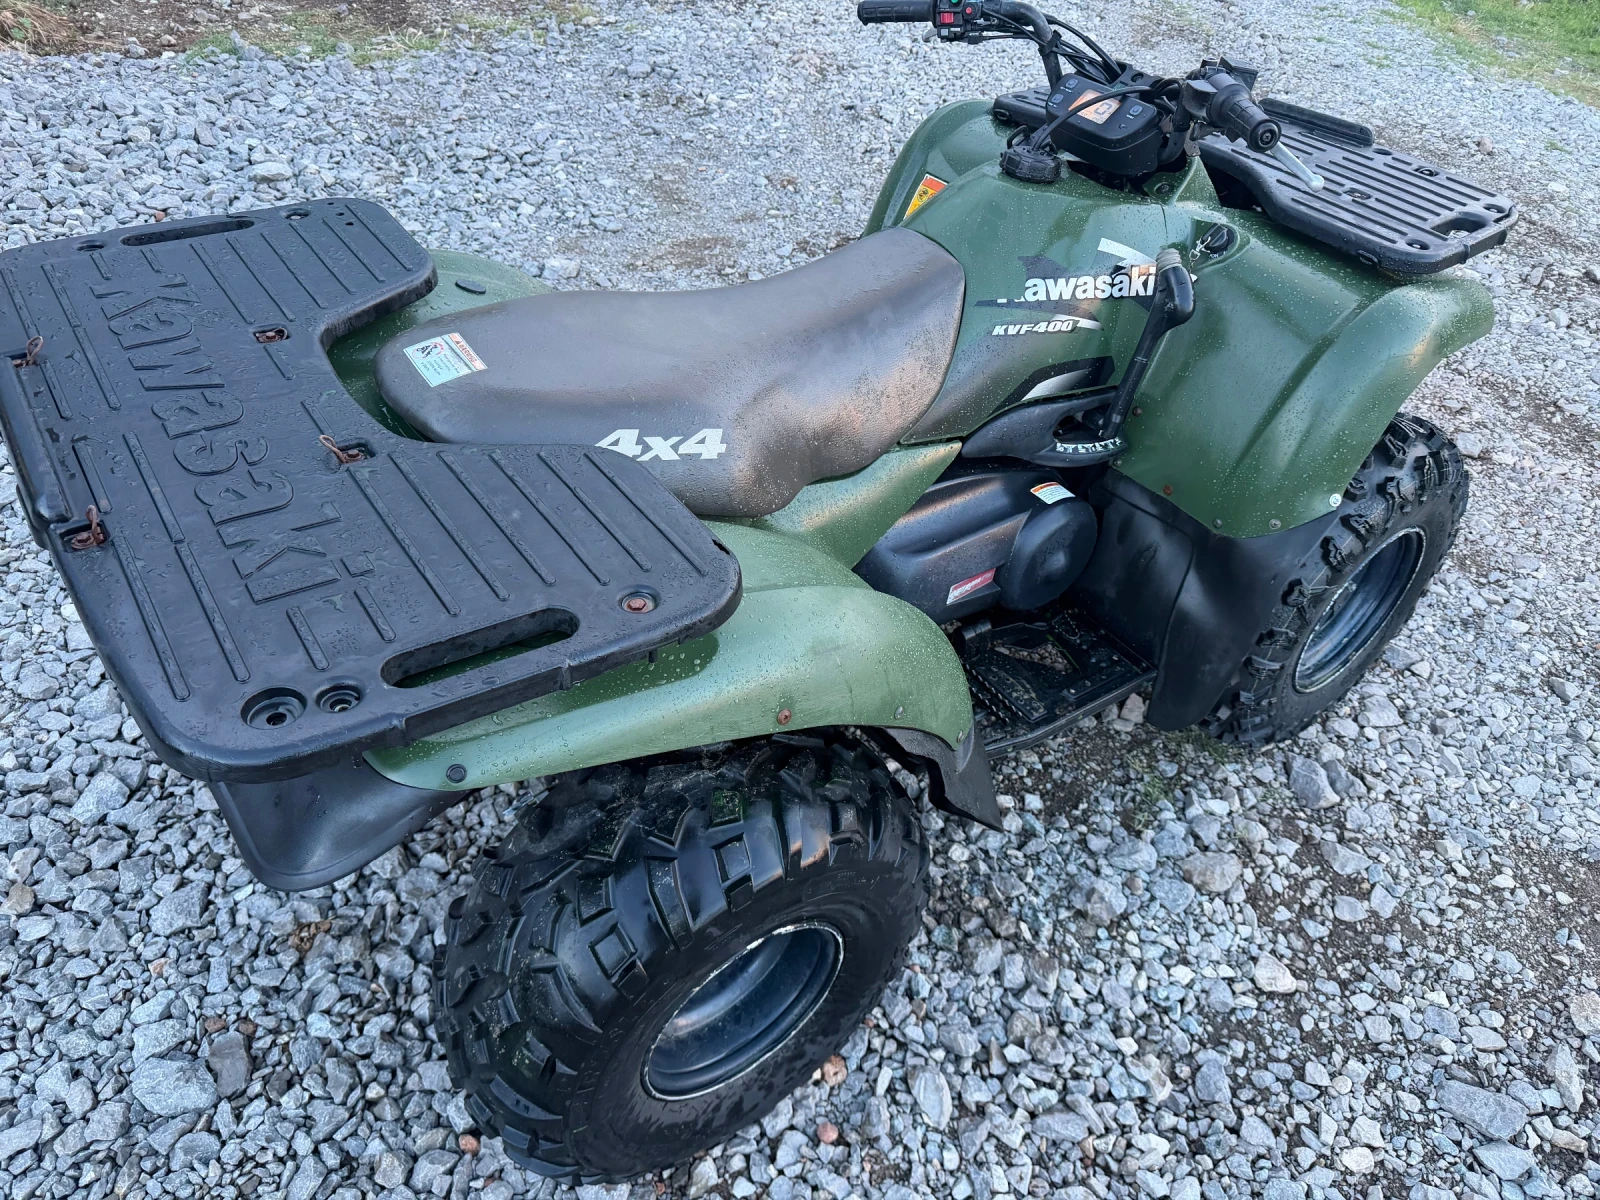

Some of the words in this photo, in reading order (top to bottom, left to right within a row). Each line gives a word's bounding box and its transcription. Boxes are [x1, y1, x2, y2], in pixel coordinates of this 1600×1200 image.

[997, 265, 1157, 303] awasaki
[992, 320, 1073, 336] KVF400
[91, 274, 374, 604] Kawasaki
[594, 428, 727, 461] 4x4
